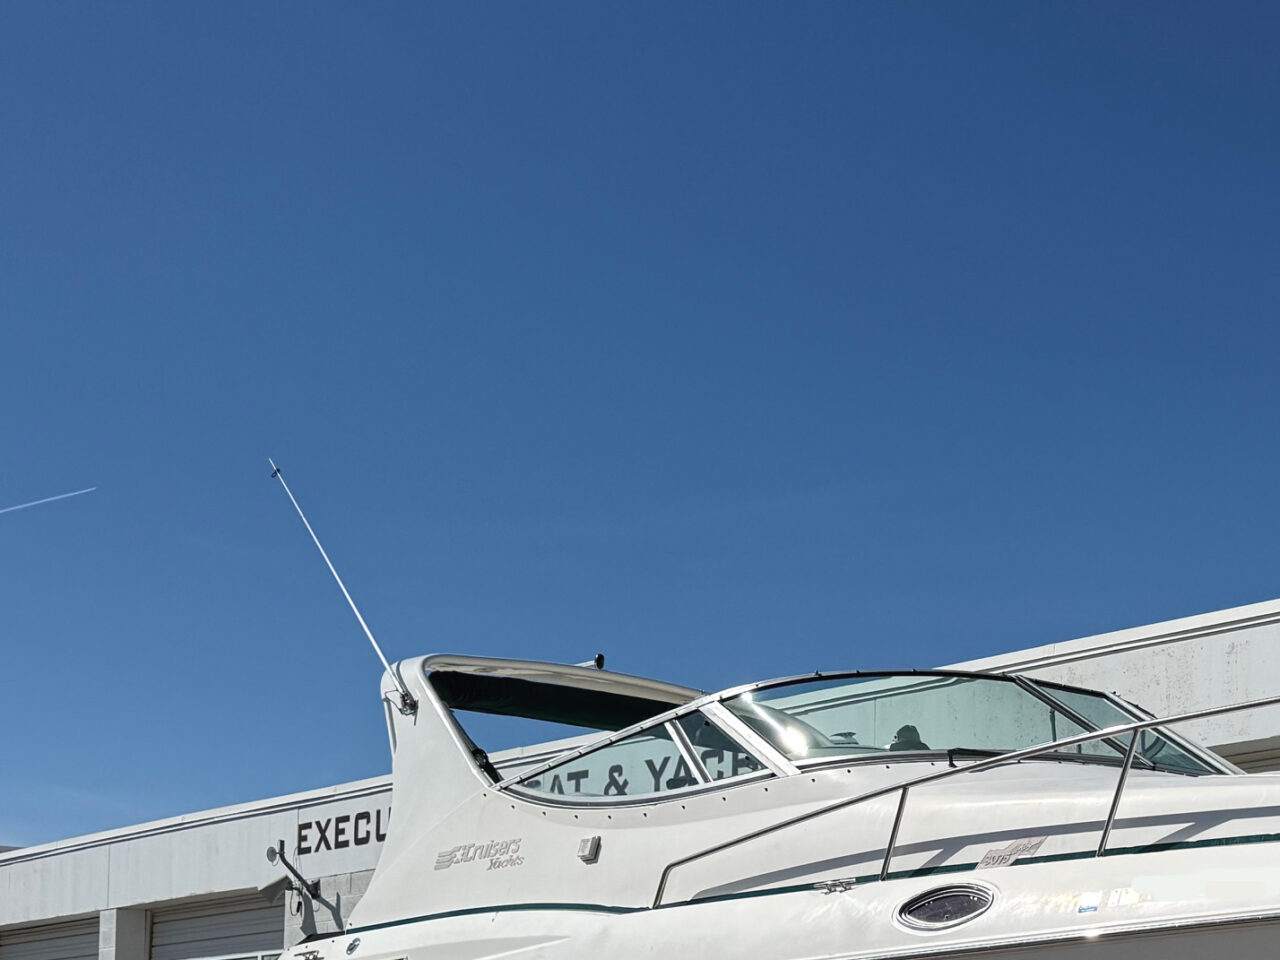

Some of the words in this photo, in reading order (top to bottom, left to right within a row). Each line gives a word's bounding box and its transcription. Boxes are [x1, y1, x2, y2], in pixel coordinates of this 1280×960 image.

[603, 764, 629, 796] &
[453, 838, 522, 864] Cruisers
[486, 855, 525, 871] Yachts
